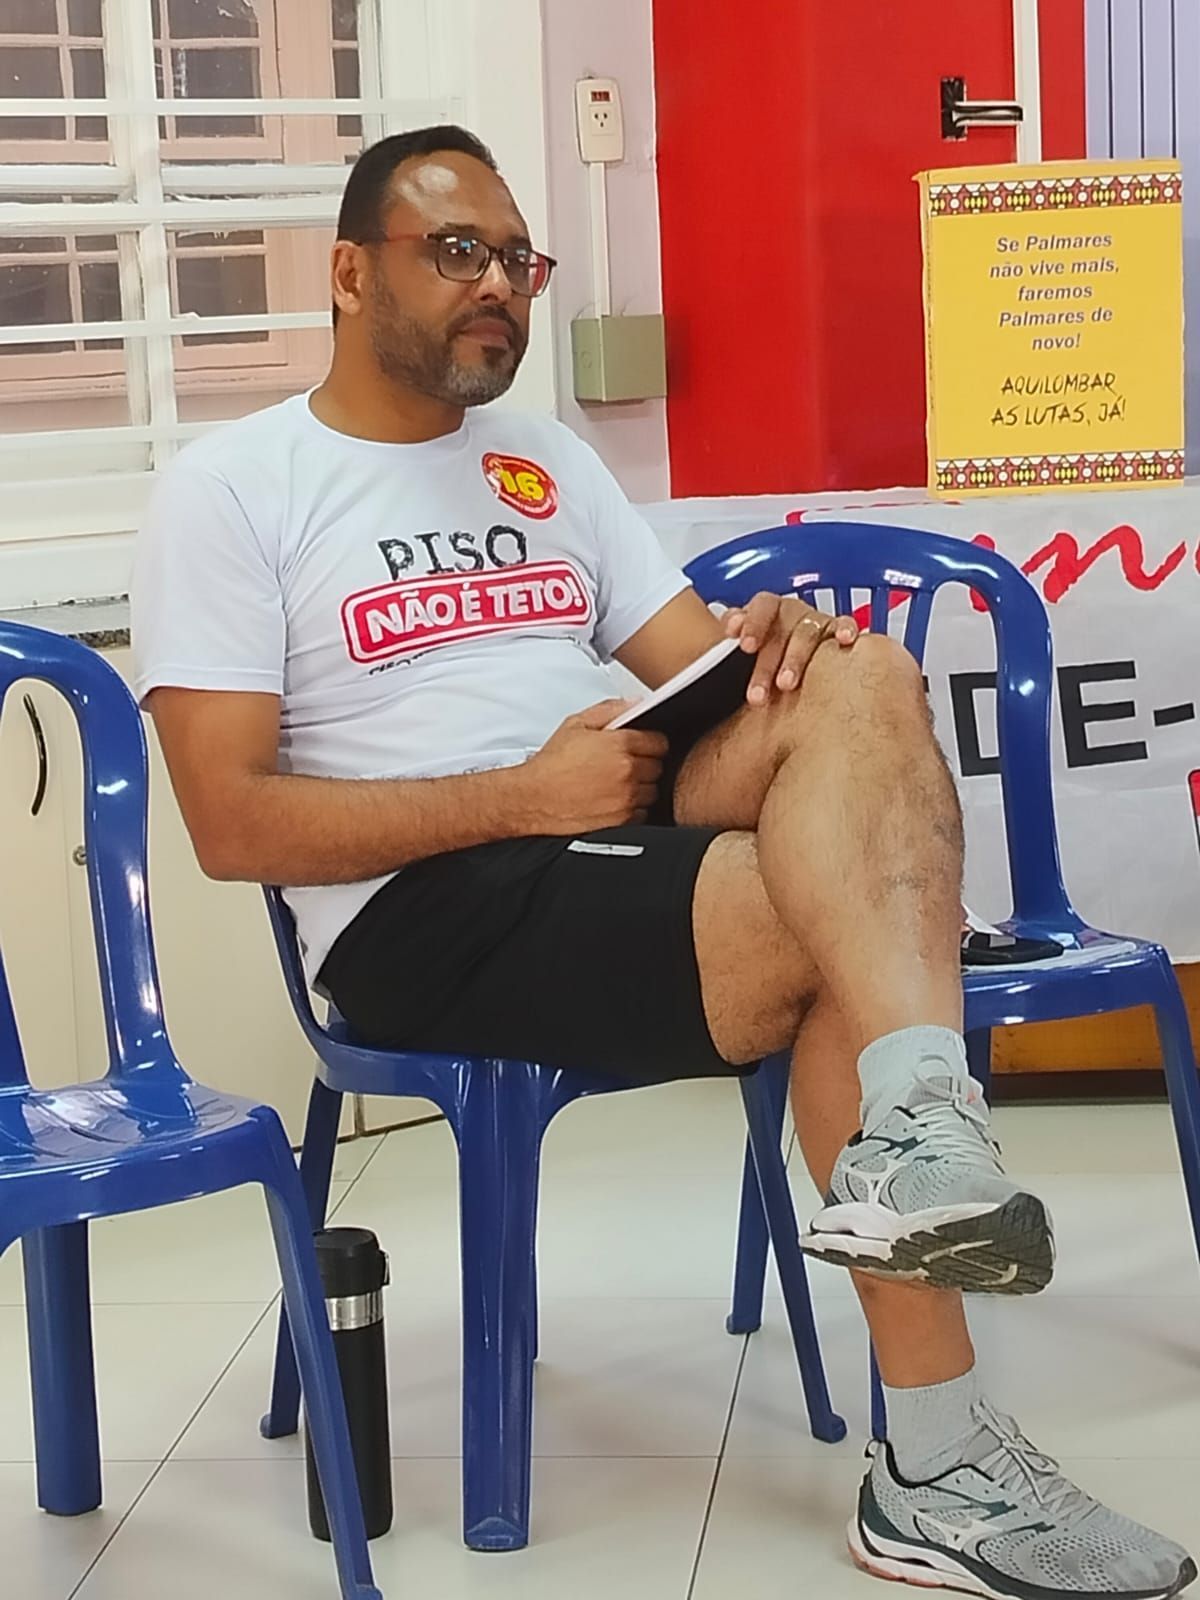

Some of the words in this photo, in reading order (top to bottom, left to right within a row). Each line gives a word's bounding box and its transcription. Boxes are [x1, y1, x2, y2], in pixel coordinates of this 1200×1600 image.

[996, 237, 1020, 253] Se
[1026, 234, 1112, 251] Palmares
[989, 260, 1024, 279] não
[1029, 259, 1065, 276] vive
[1071, 257, 1120, 275] mais,
[1018, 285, 1093, 302] faremos
[999, 311, 1085, 328] Palmares
[1091, 306, 1113, 323] de
[1032, 333, 1081, 350] novo!
[1001, 372, 1118, 396] AQUILOMBAR
[991, 405, 1020, 426] AS
[1024, 401, 1092, 426] LUTAS,
[1098, 395, 1126, 422] JÁ!
[499, 468, 545, 501] 16
[377, 524, 528, 581] PISO
[365, 589, 457, 644] NÃO
[461, 581, 483, 623] É
[486, 575, 584, 619] TETO!
